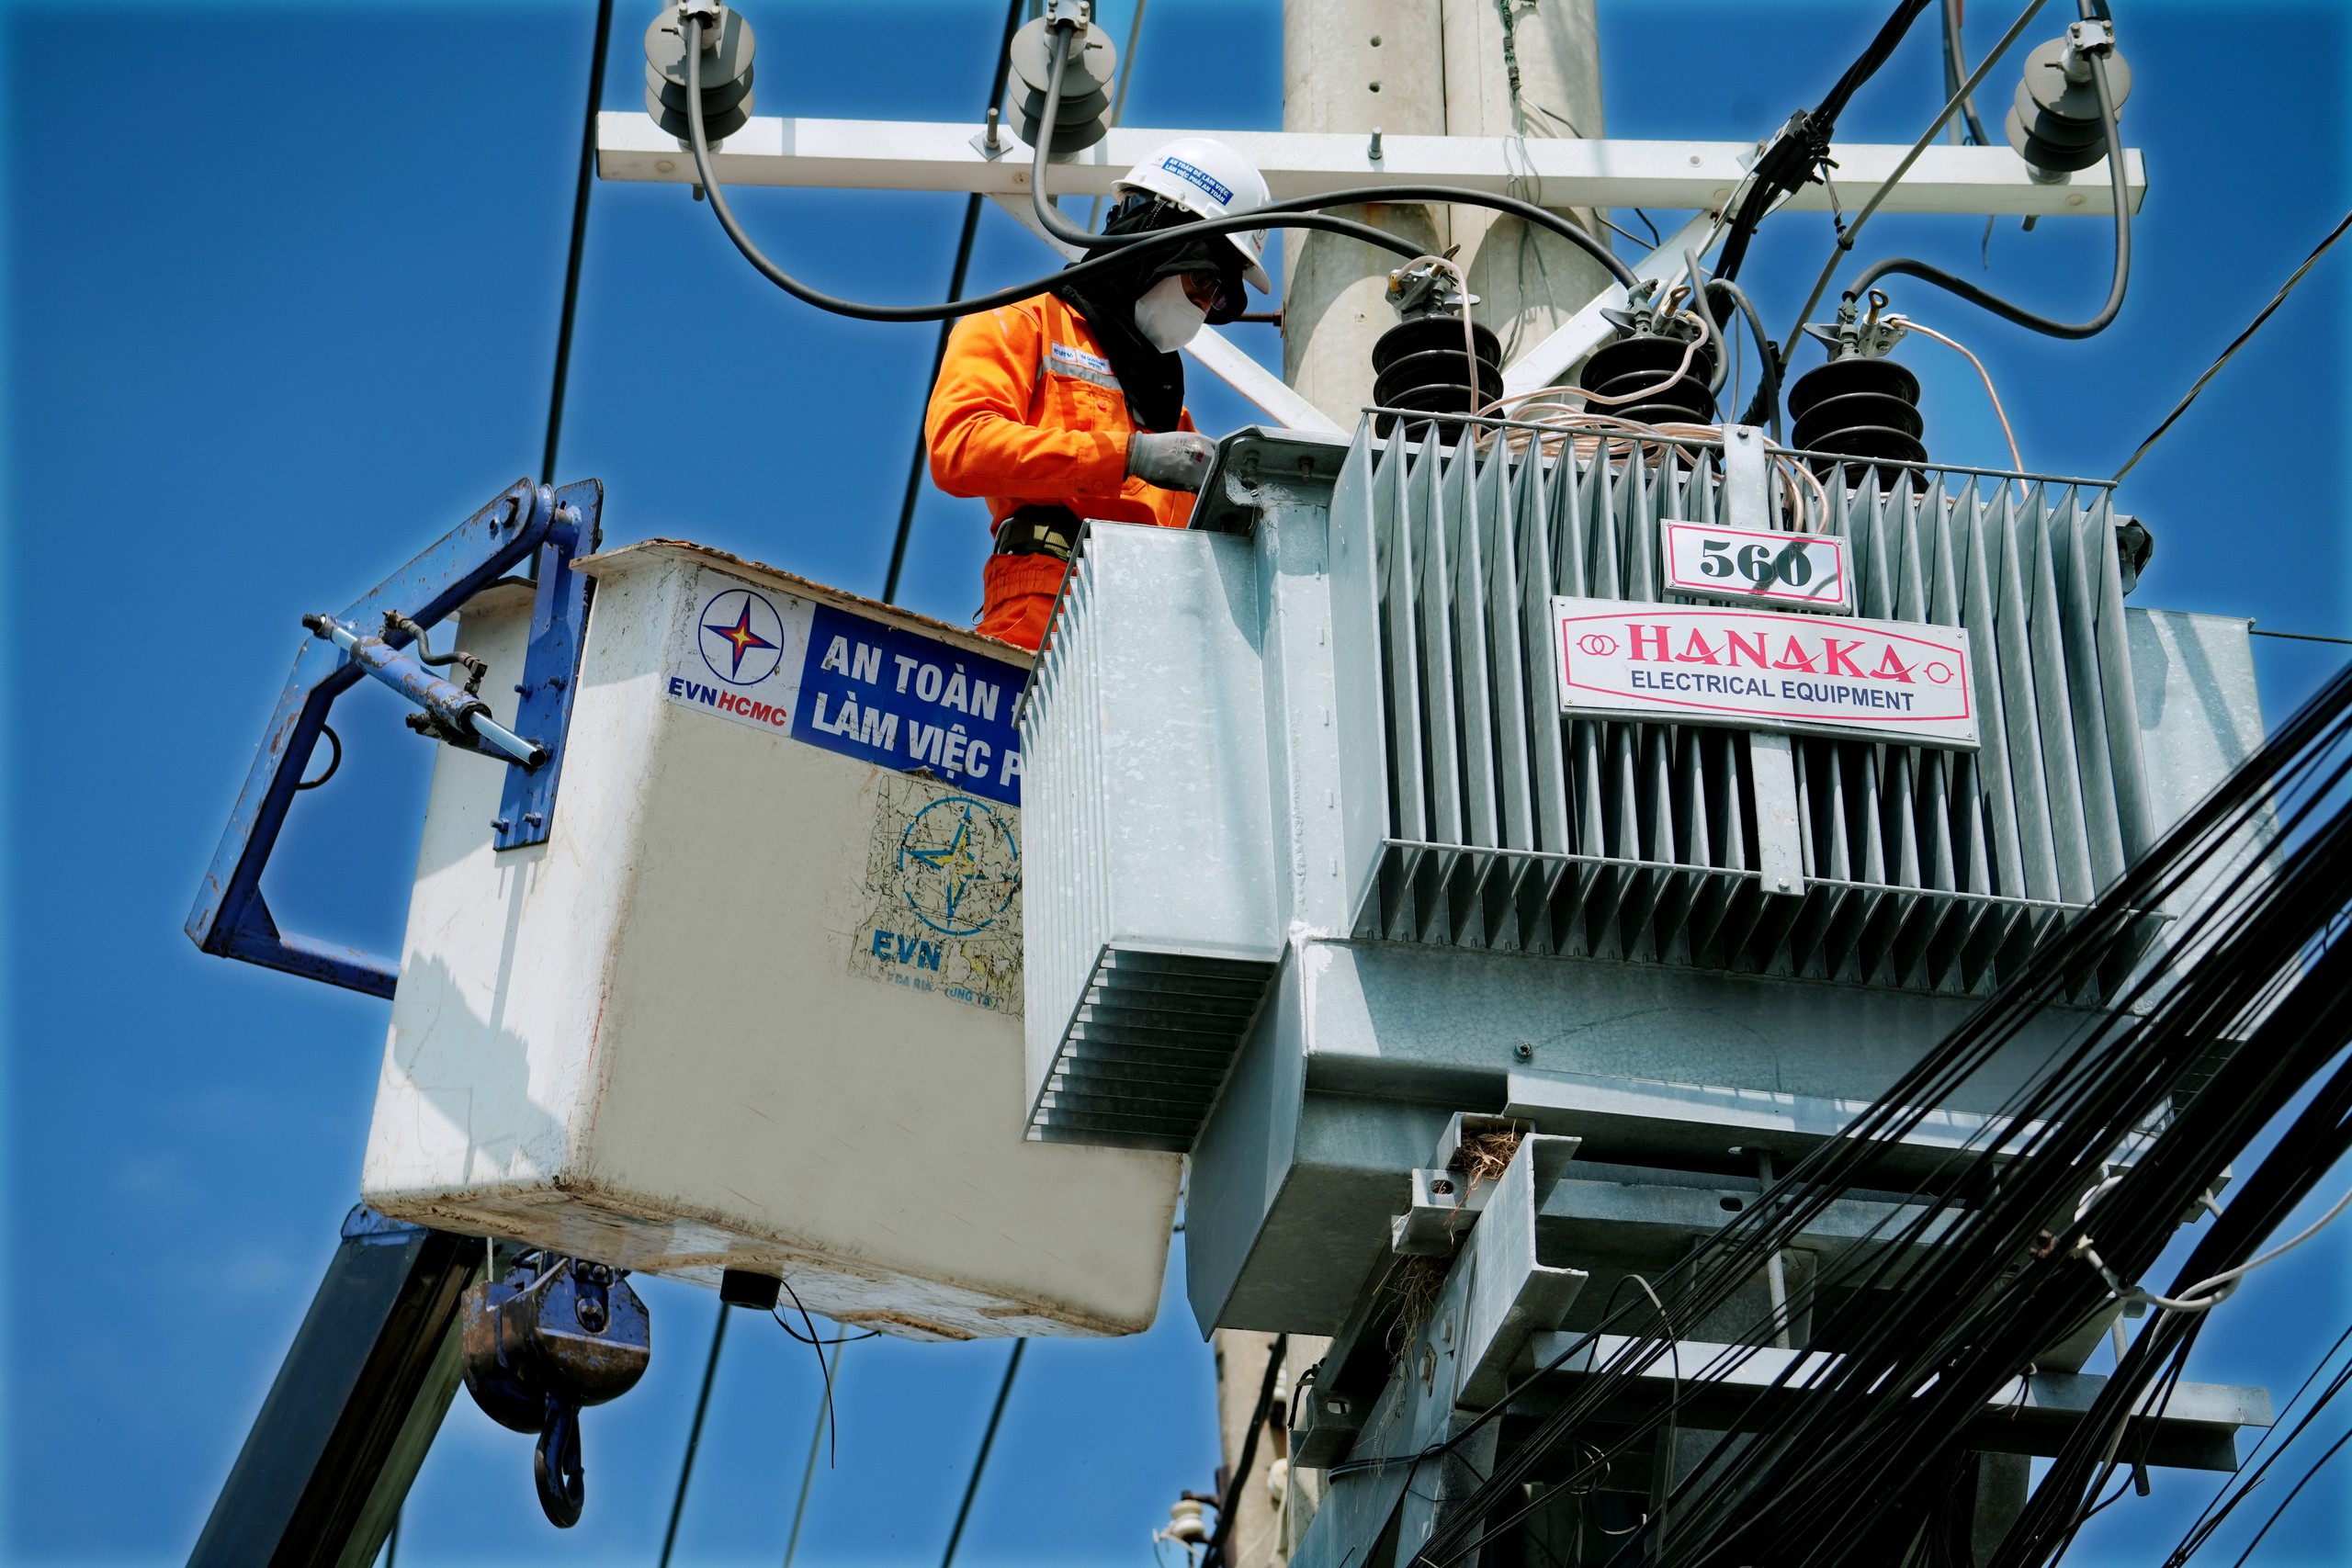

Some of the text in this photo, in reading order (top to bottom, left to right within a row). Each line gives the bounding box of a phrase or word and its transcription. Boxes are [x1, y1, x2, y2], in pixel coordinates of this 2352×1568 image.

[1700, 539, 1813, 588] 560
[820, 635, 882, 685] AN
[894, 653, 1001, 722] TOÀN
[1624, 623, 1922, 684] HANAKA
[1631, 670, 1914, 712] ELECTRICAL EQUIPMENT
[811, 692, 899, 752] LÀM
[908, 719, 992, 780] VIỆC
[872, 929, 942, 972] EVN
